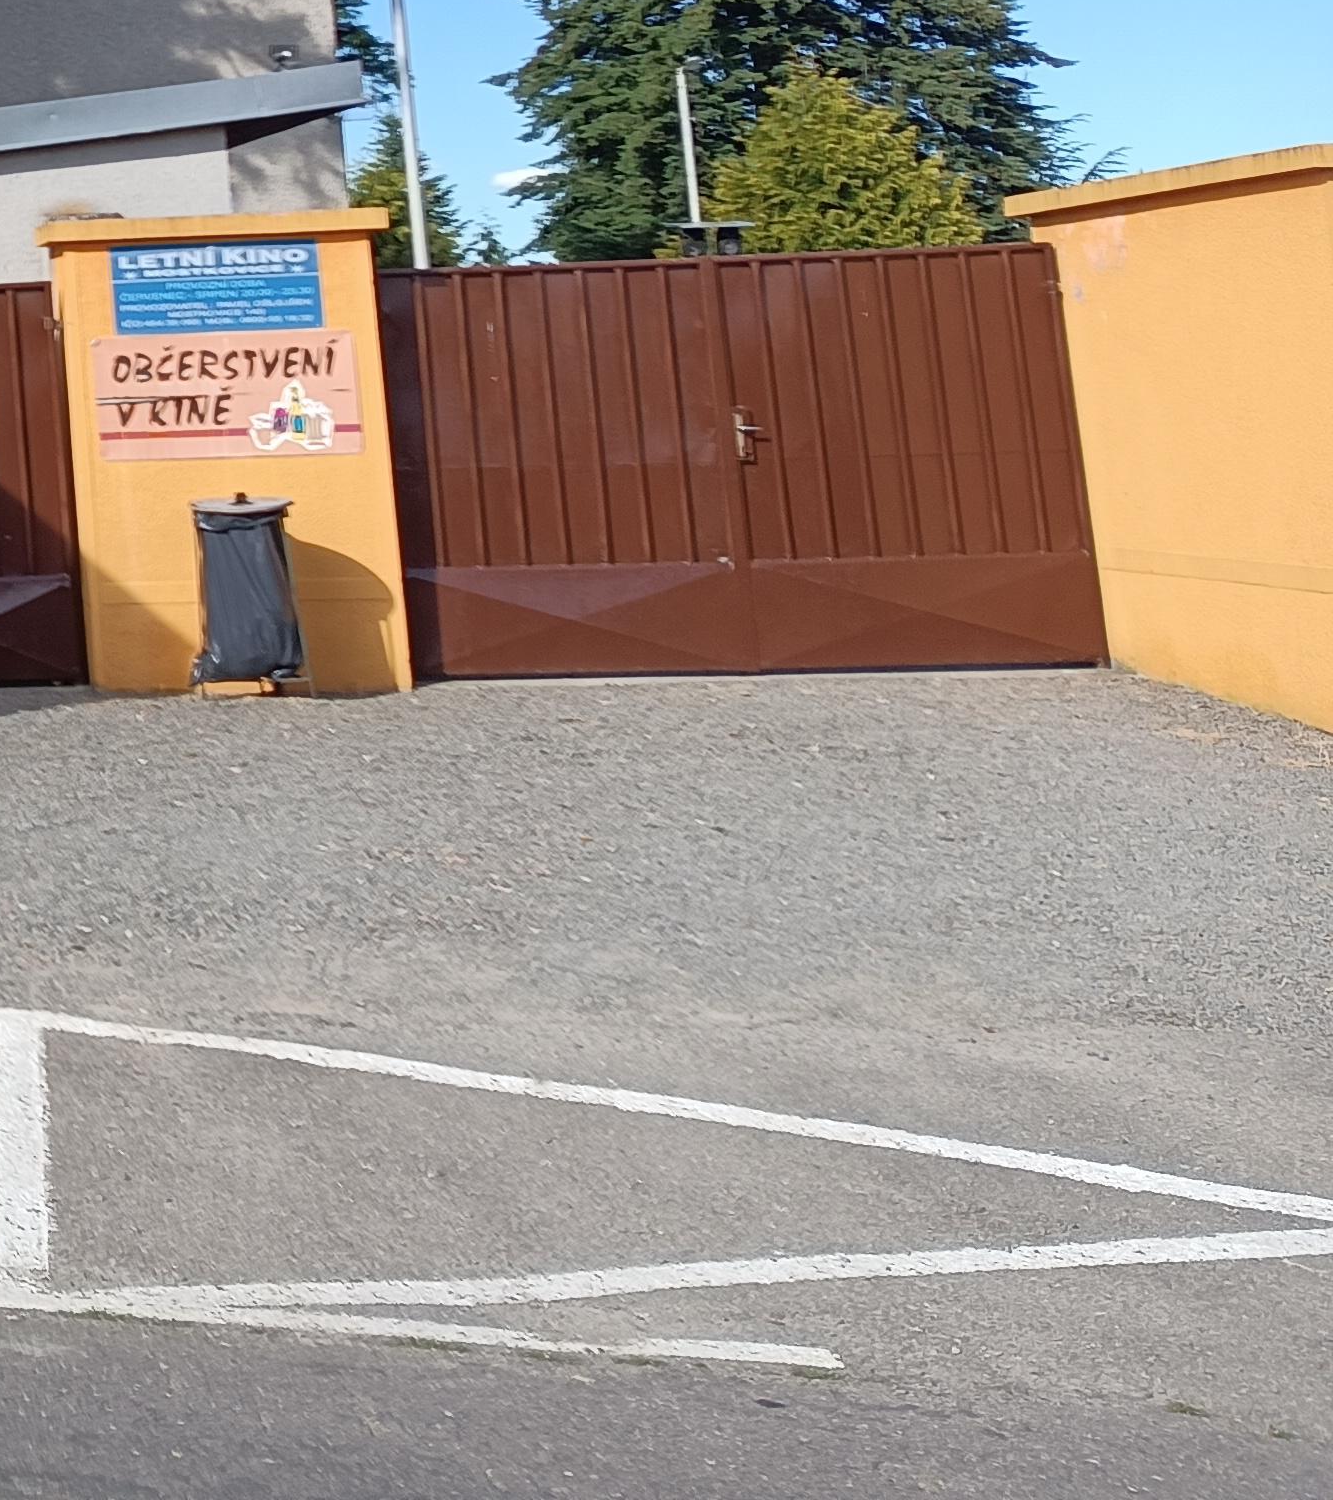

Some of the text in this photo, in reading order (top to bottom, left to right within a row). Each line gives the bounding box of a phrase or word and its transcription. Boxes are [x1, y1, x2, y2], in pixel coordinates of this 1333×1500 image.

[117, 246, 309, 269] LETNÍ KINO
[111, 339, 339, 383] OBČERSTVENÍ
[117, 386, 233, 427] V KINĚ
